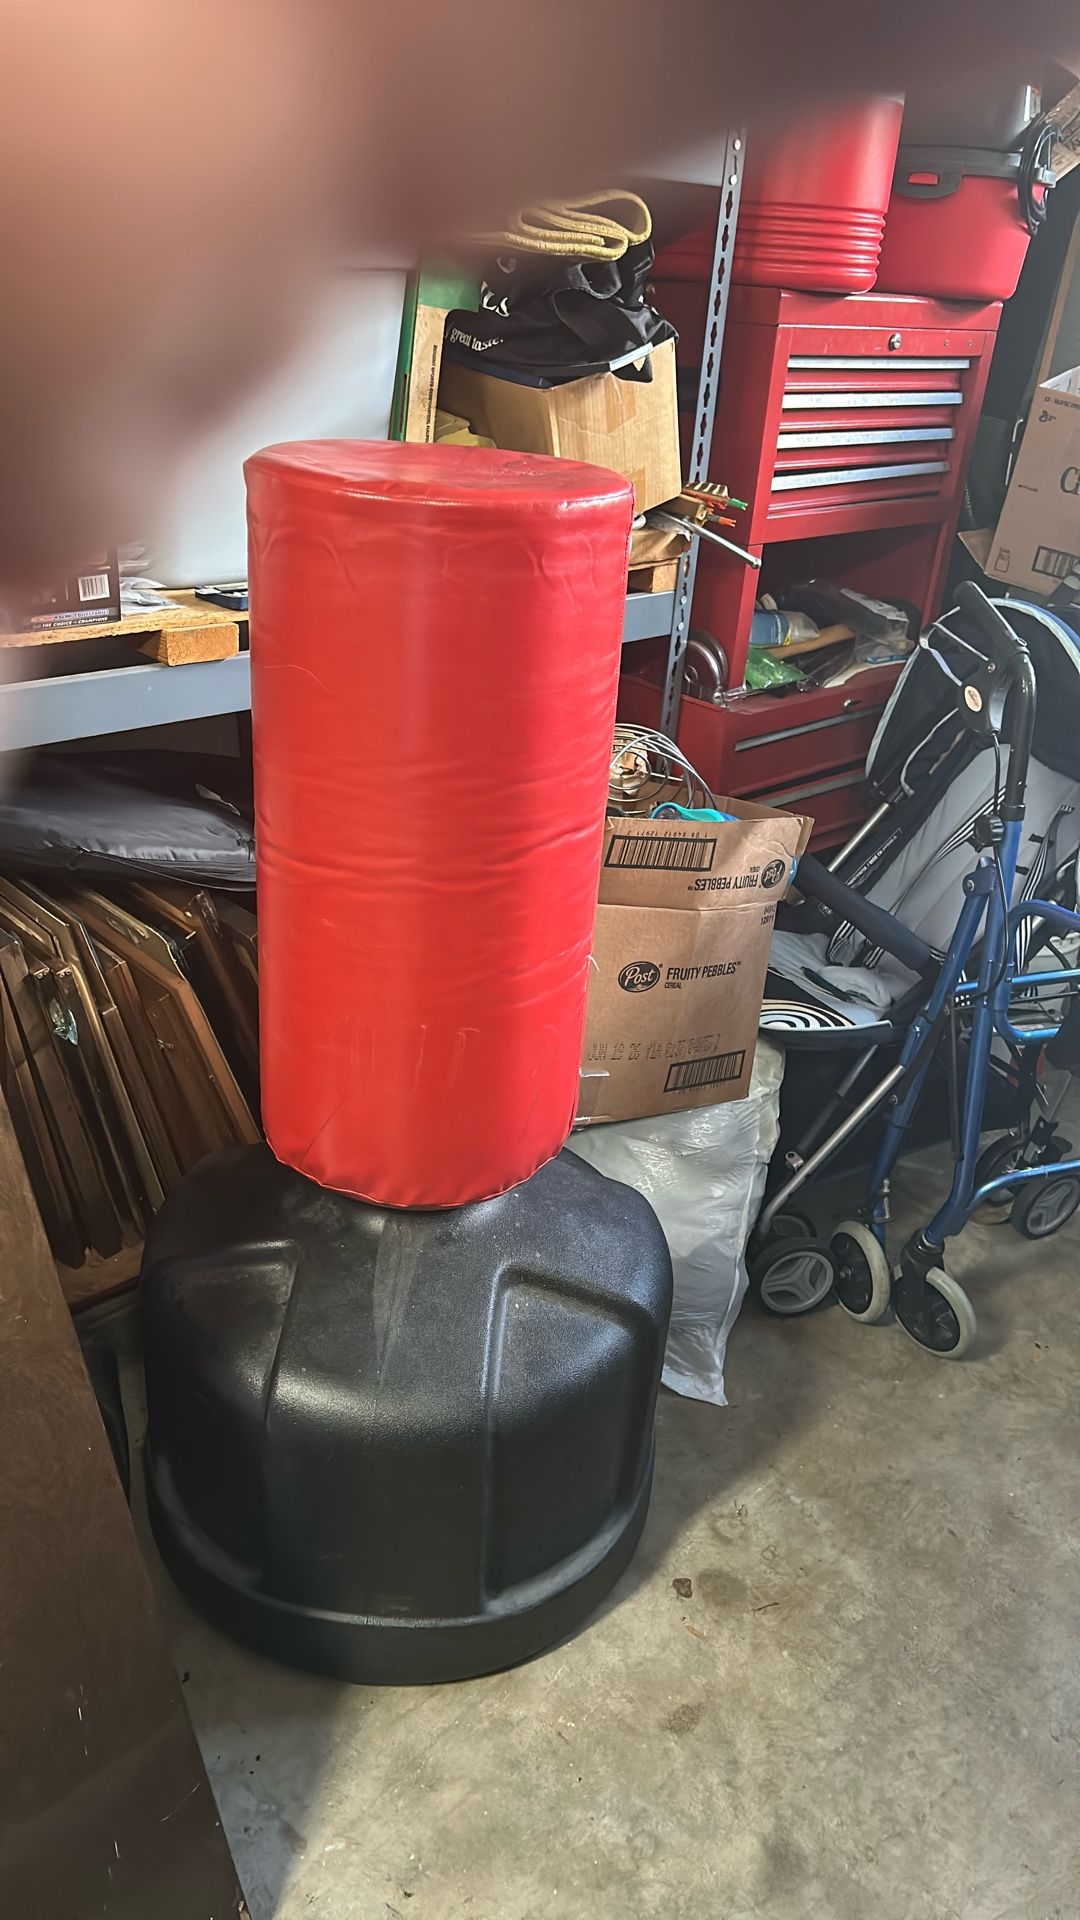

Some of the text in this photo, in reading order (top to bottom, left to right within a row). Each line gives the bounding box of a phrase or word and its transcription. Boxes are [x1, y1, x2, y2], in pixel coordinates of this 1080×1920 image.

[732, 873, 759, 889] FRUITY
[623, 966, 656, 988] Post
[666, 966, 702, 981] FRUITY
